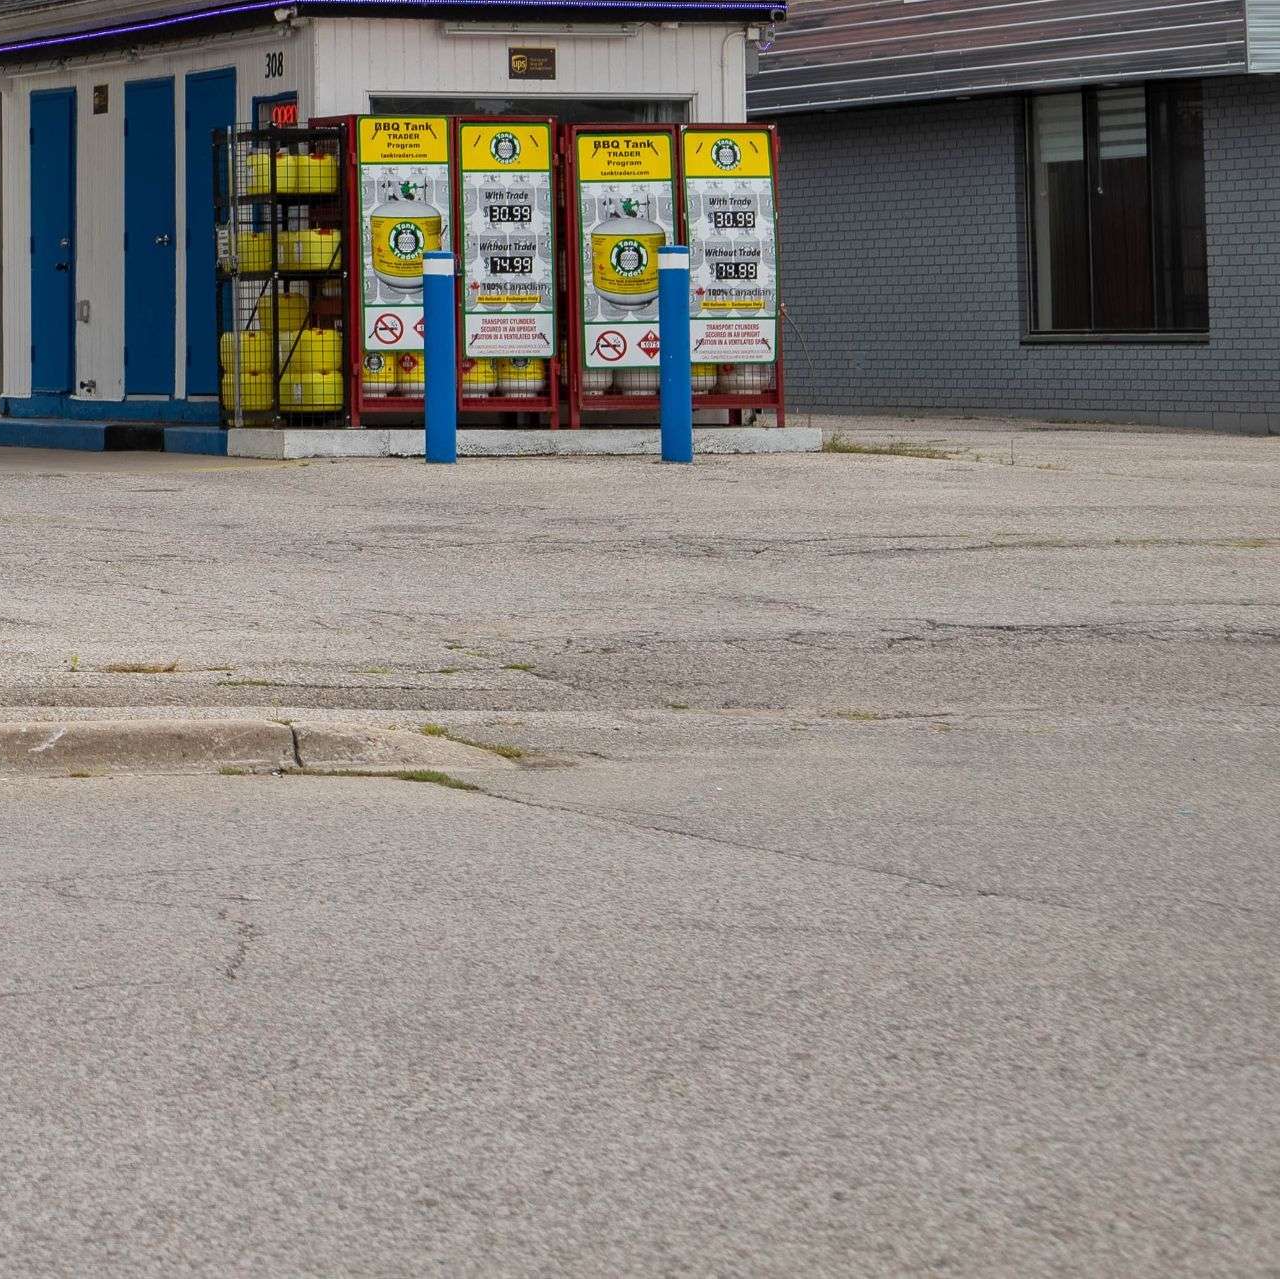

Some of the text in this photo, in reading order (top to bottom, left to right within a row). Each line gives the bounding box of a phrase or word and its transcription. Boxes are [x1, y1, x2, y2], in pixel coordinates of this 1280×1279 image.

[264, 51, 284, 79] 308
[375, 122, 432, 131] BBQ Tank
[387, 142, 421, 150] Program
[593, 140, 653, 149] BBQ Tank
[485, 191, 529, 200] With Trade
[709, 197, 752, 206] With Trade
[396, 222, 416, 231] Tank
[480, 241, 537, 251] Without Trade
[618, 240, 639, 249] Tank
[705, 247, 761, 257] Without Trade
[482, 282, 547, 291] 100% Canadian
[708, 287, 771, 296] 100% Canadian
